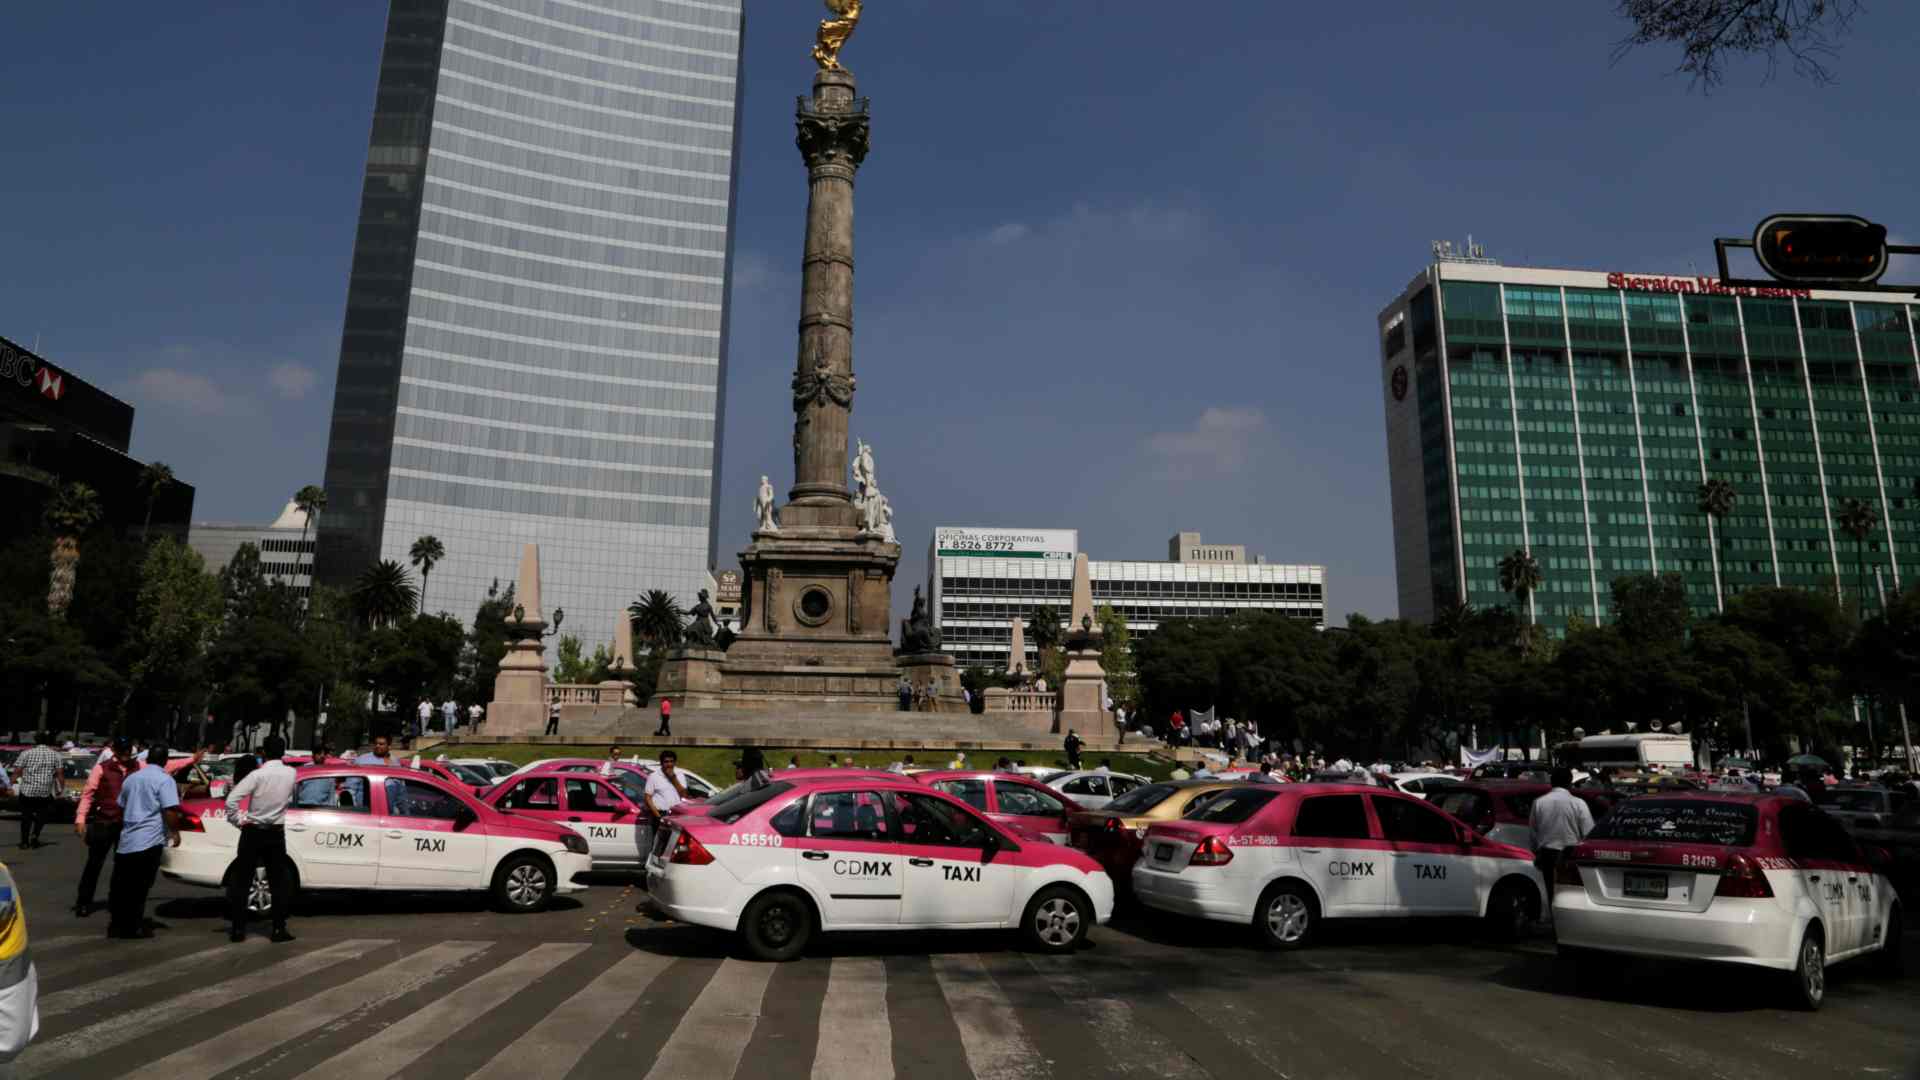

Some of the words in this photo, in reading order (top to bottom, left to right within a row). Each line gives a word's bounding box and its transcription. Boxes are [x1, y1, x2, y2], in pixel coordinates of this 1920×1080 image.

[1608, 272, 1695, 294] Sheraton
[938, 534, 979, 542] OFICINAS
[981, 534, 1045, 543] CORPORATIVAS
[952, 541, 982, 549] 8526
[985, 541, 1014, 550] 8772
[314, 831, 364, 847] CDMX
[588, 826, 617, 838] TAXI
[414, 838, 446, 852] TAXI
[833, 860, 892, 876] CDMX
[942, 865, 980, 882] TAXI
[1328, 861, 1374, 876] CDMX
[1413, 864, 1447, 880] TAXI
